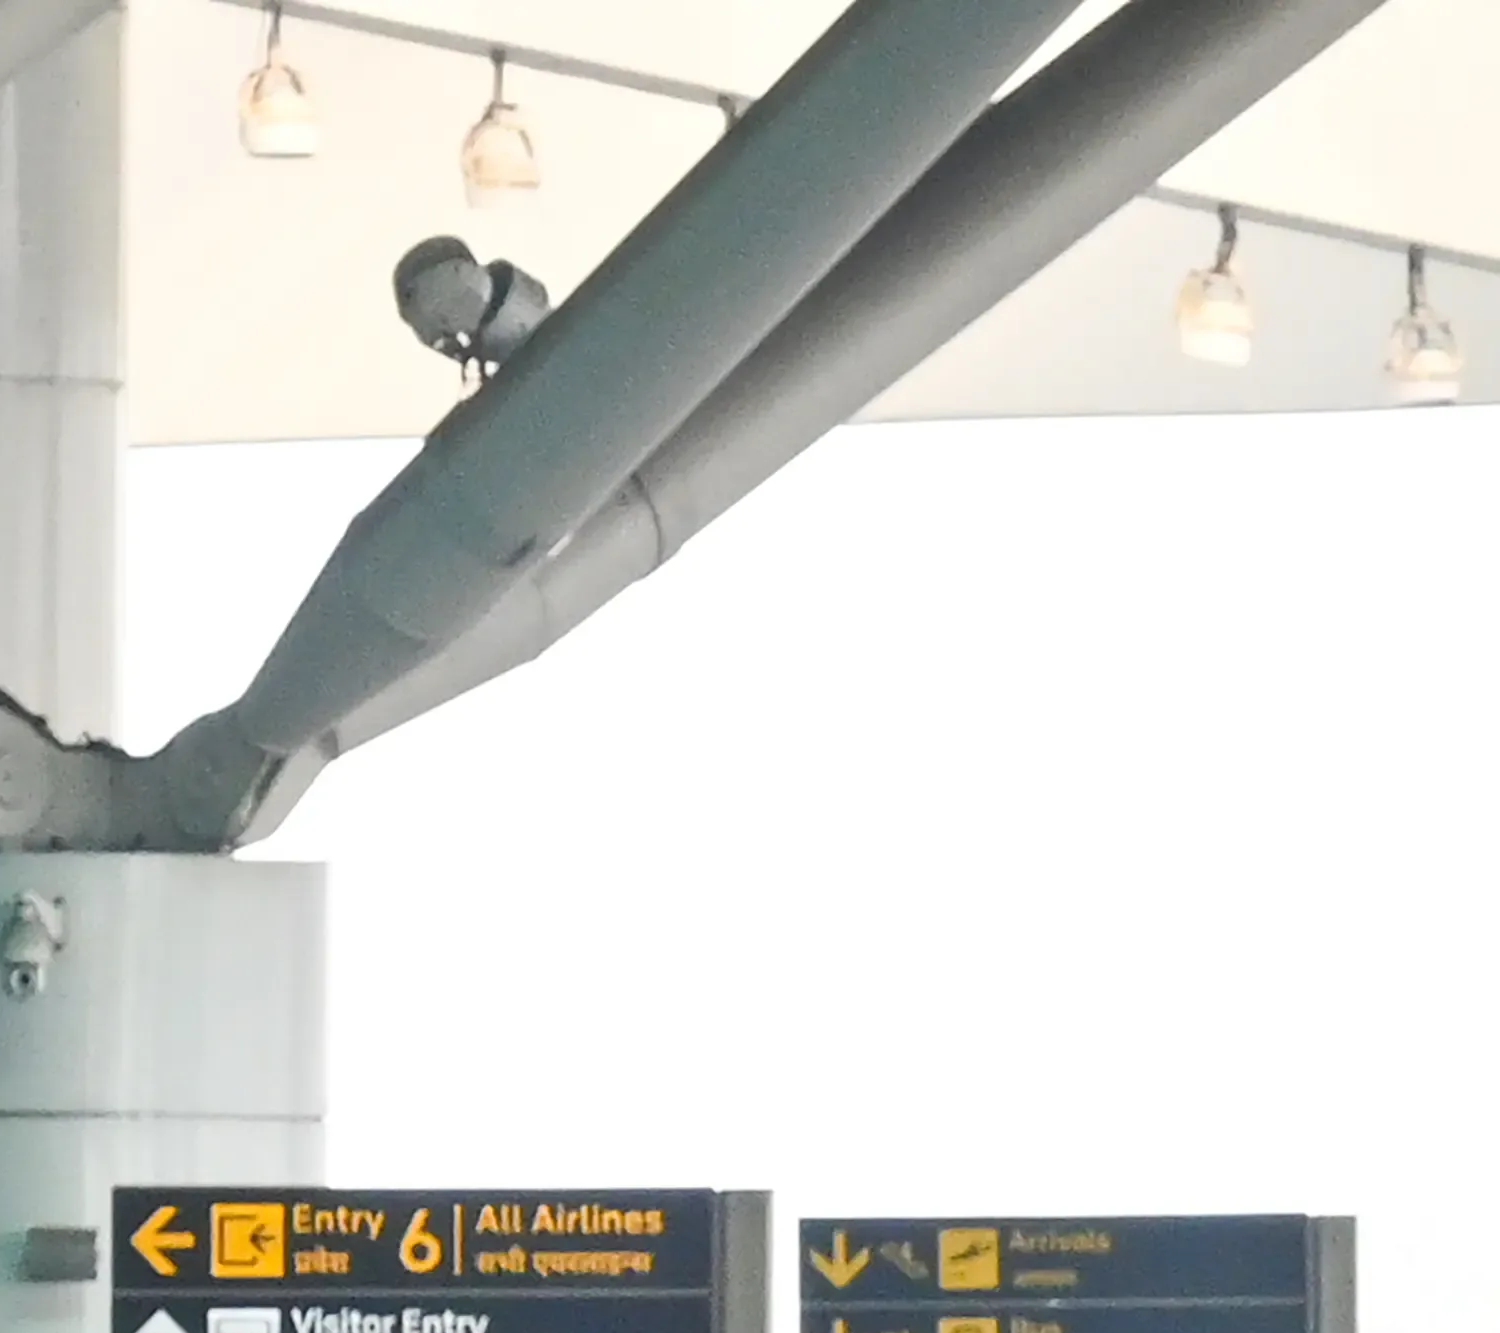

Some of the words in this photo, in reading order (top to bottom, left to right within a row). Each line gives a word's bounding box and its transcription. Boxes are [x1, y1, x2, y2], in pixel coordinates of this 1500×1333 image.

[293, 1203, 384, 1241] Entry
[399, 1207, 442, 1273] 6
[475, 1204, 522, 1234] All
[531, 1204, 664, 1235] Airlines
